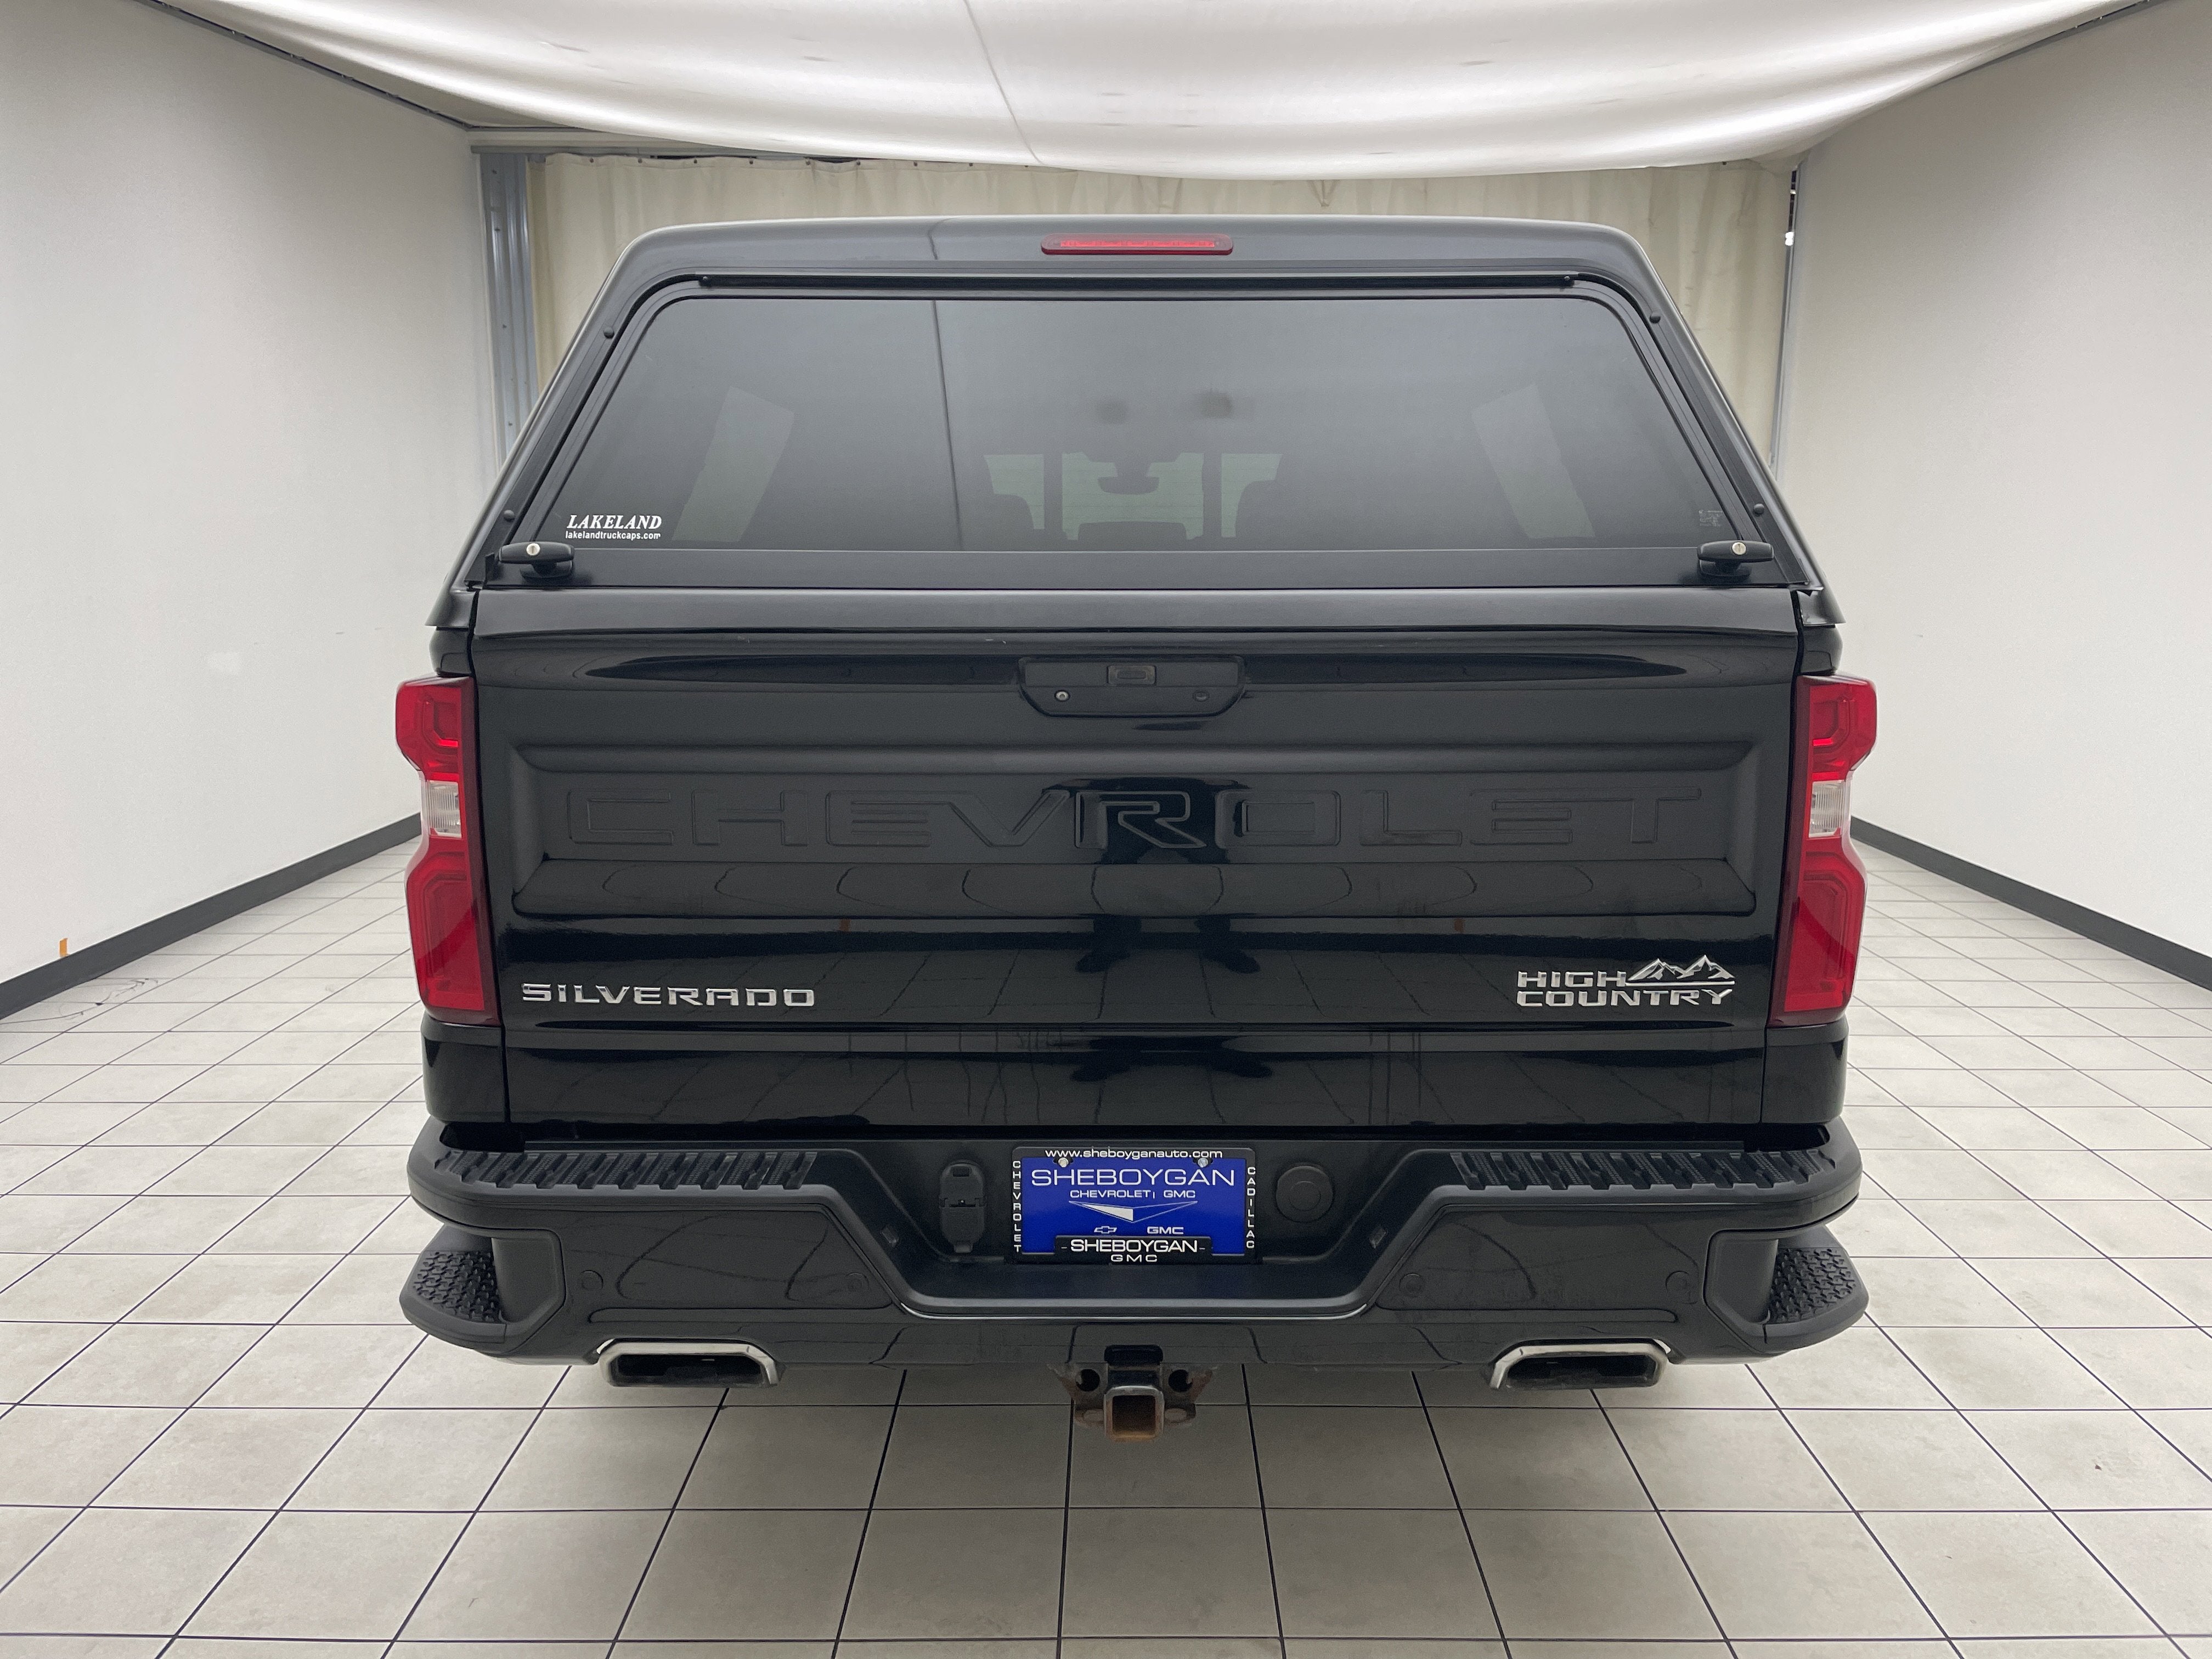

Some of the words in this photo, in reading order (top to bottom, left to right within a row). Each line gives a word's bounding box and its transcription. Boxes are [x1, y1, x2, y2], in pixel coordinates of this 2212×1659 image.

[567, 515, 662, 529] LAKELAND
[565, 531, 661, 541] lakelandtruckcaps.com
[567, 787, 1702, 850] CHEVROLET
[1517, 971, 1627, 988] HIGH
[522, 983, 815, 1006] SILVERADO
[1517, 989, 1733, 1006] COUNTRY
[1045, 1148, 1223, 1160] www.sheboyganauto.com
[1031, 1169, 1234, 1186] SHEBOYGAN
[1070, 1189, 1151, 1198] CHEVROLET
[1163, 1190, 1196, 1198] GMC
[1013, 1160, 1022, 1252] CHEVROLET
[1246, 1166, 1256, 1249] CADILLAC
[1147, 1227, 1184, 1235] GMC
[1070, 1239, 1198, 1252] SHEBOYGAN
[1110, 1254, 1158, 1262] GMC
